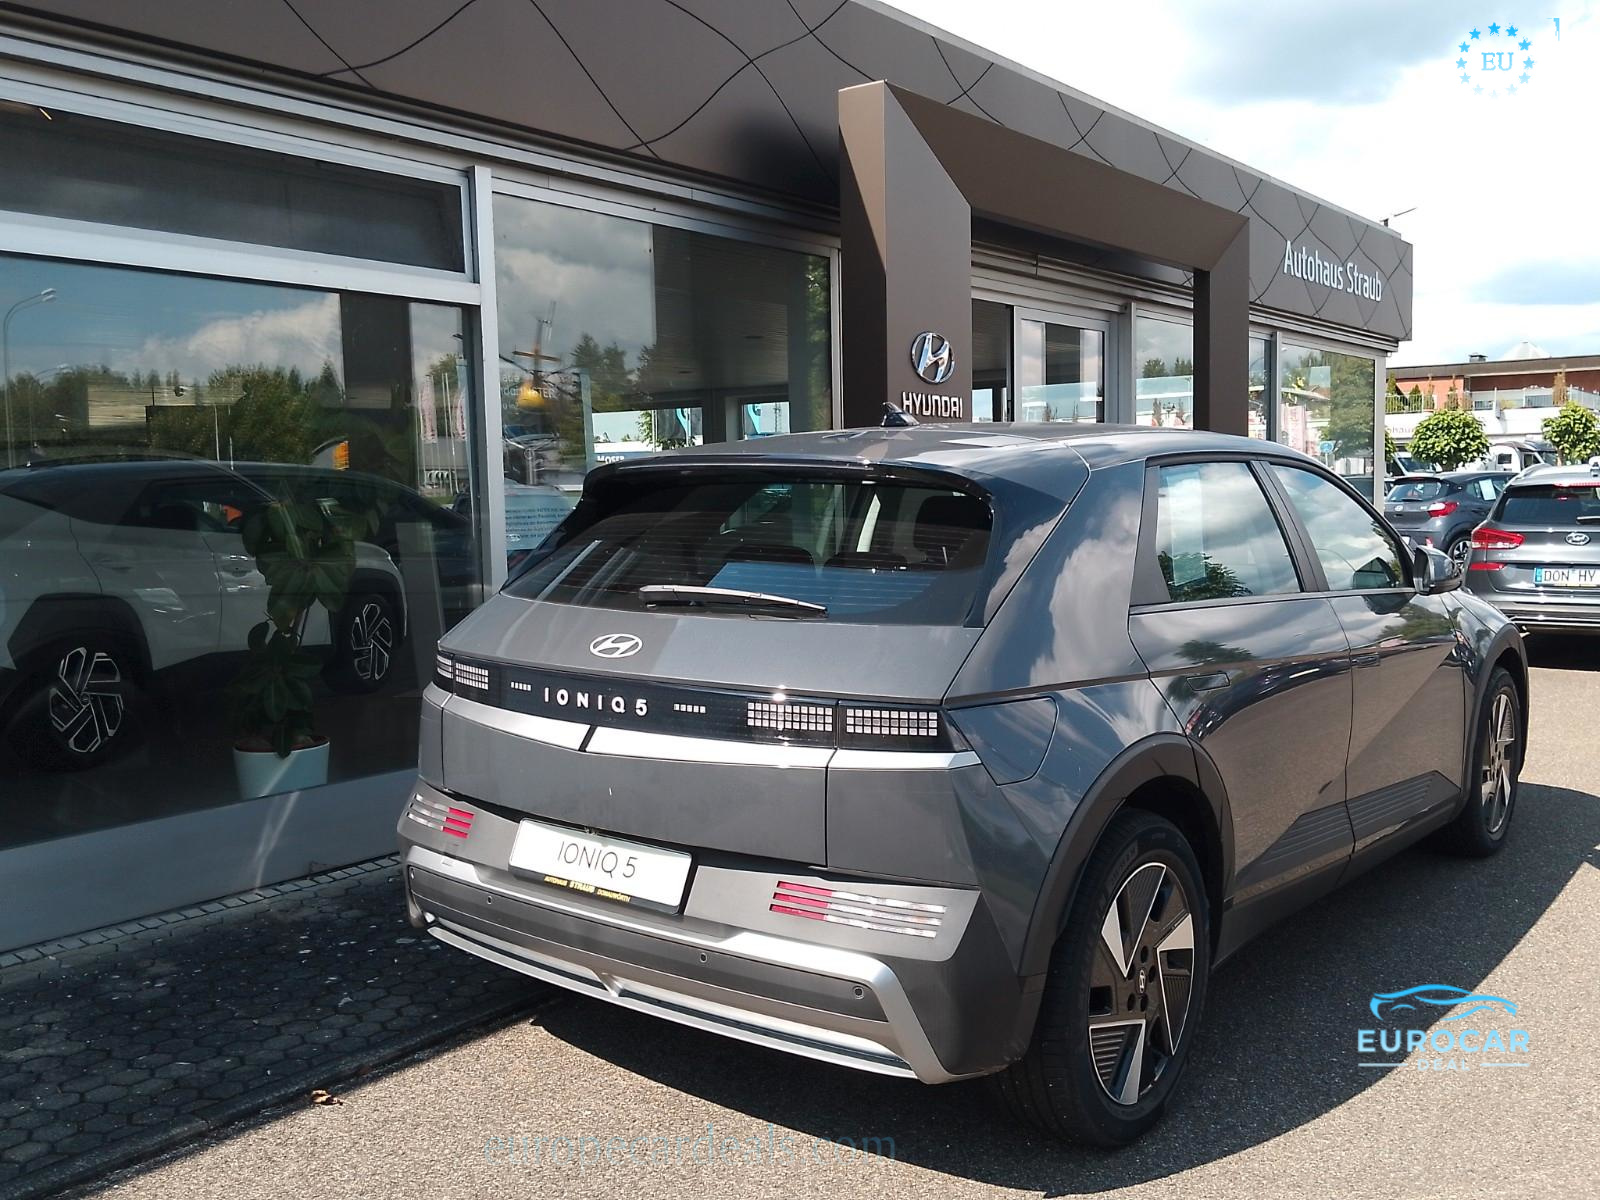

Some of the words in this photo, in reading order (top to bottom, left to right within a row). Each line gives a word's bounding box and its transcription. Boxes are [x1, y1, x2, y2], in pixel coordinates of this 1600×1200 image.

[1284, 240, 1344, 290] Autohaus
[1346, 262, 1382, 302] Straub
[902, 391, 963, 418] HYUNDAI
[1544, 570, 1569, 581] DON
[1578, 570, 1596, 582] HY
[544, 687, 626, 714] IONIQ
[635, 698, 648, 717] 5
[557, 840, 619, 879] IONIQ
[622, 856, 638, 878] 5
